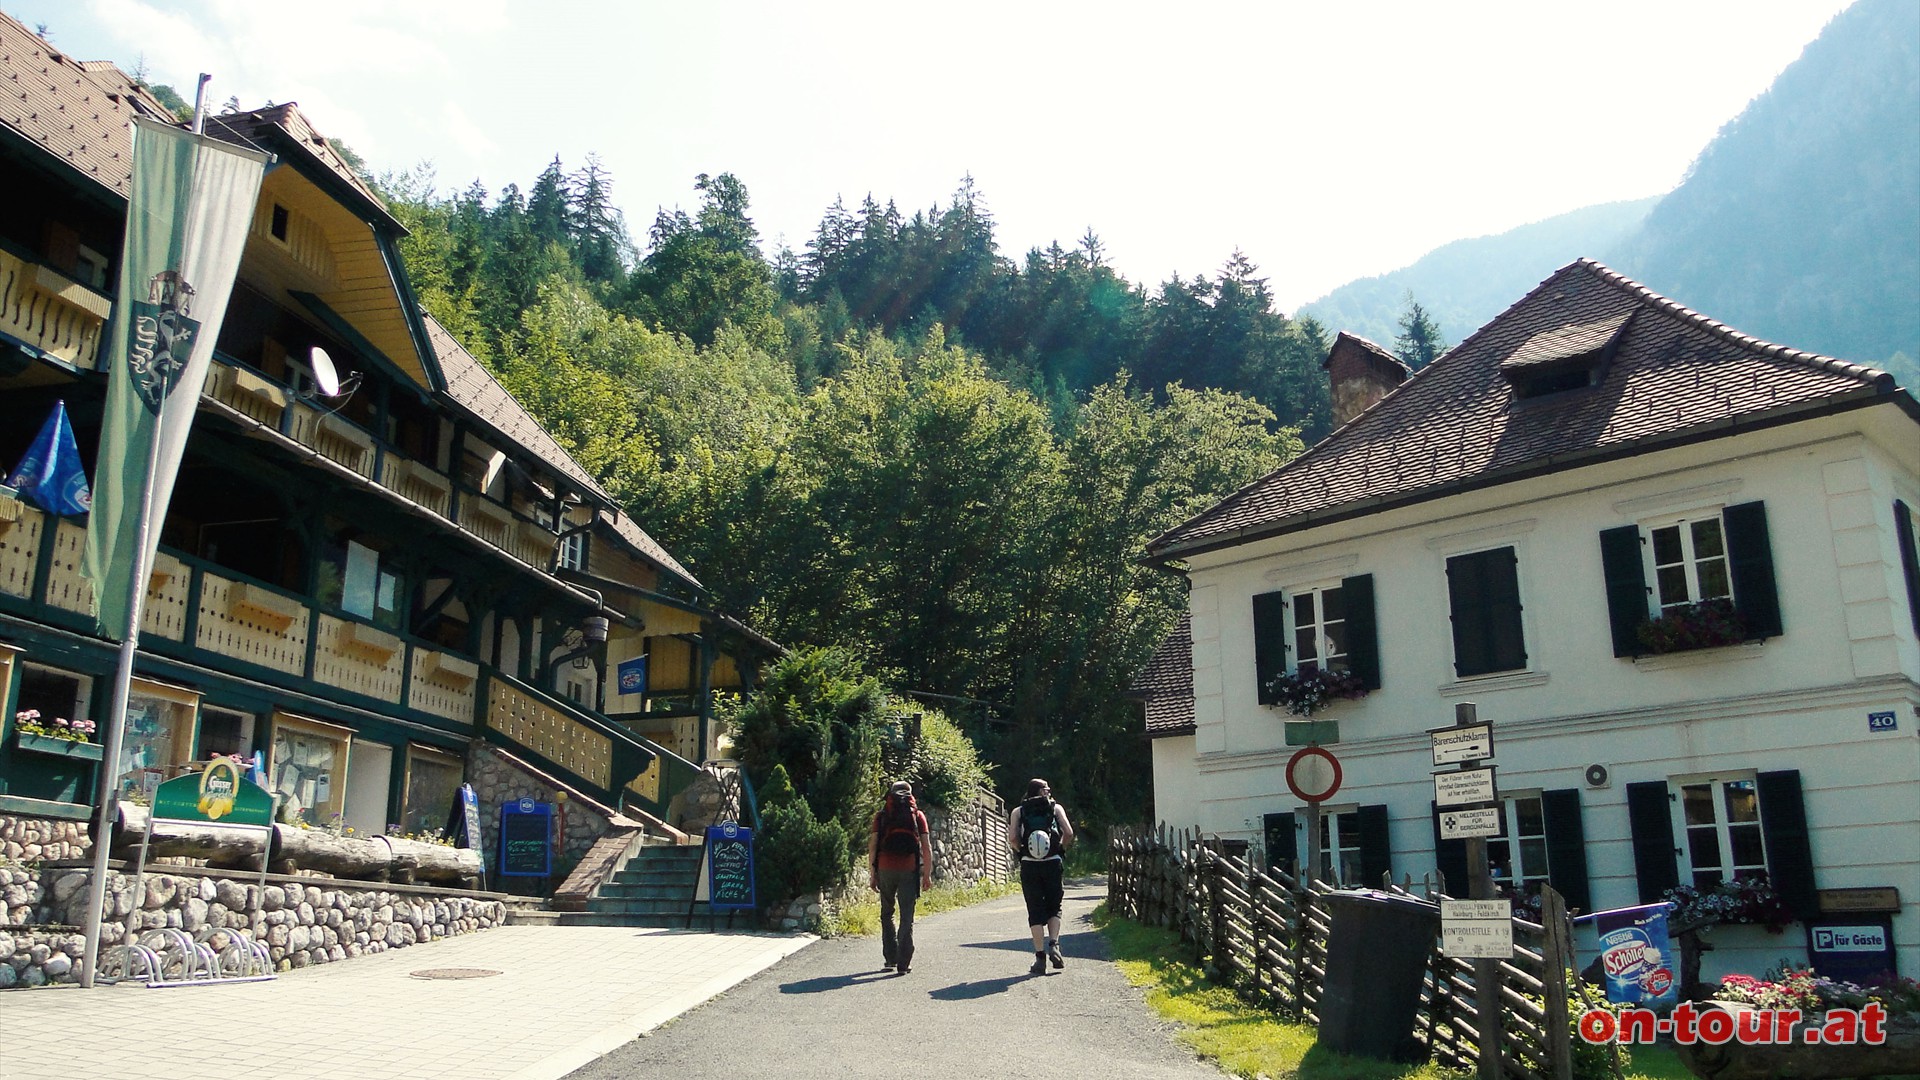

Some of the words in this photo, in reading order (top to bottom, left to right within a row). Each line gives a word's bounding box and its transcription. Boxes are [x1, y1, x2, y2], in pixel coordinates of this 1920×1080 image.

[1871, 716, 1894, 726] 40
[1443, 927, 1491, 936] KONTROLLSTELLE
[1834, 934, 1850, 946] für
[1852, 934, 1882, 946] Gäste
[1605, 944, 1647, 975] Schöller
